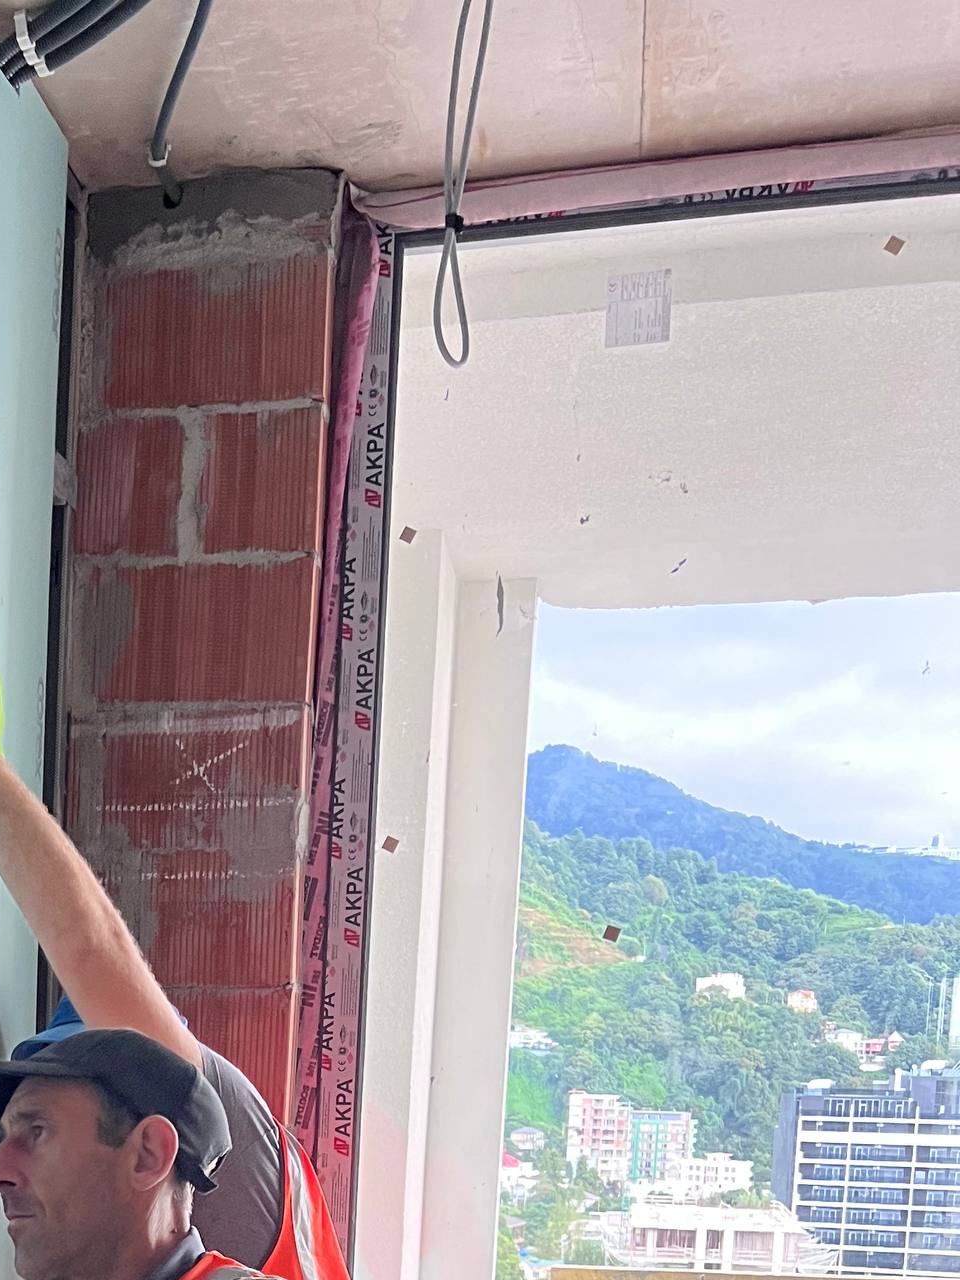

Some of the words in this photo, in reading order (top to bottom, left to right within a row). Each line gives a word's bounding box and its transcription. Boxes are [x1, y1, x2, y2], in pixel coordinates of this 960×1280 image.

[366, 422, 385, 487] AKPA
[356, 647, 375, 711] AKPA
[346, 866, 364, 927] AKPA
[336, 1078, 354, 1138] AKPA
